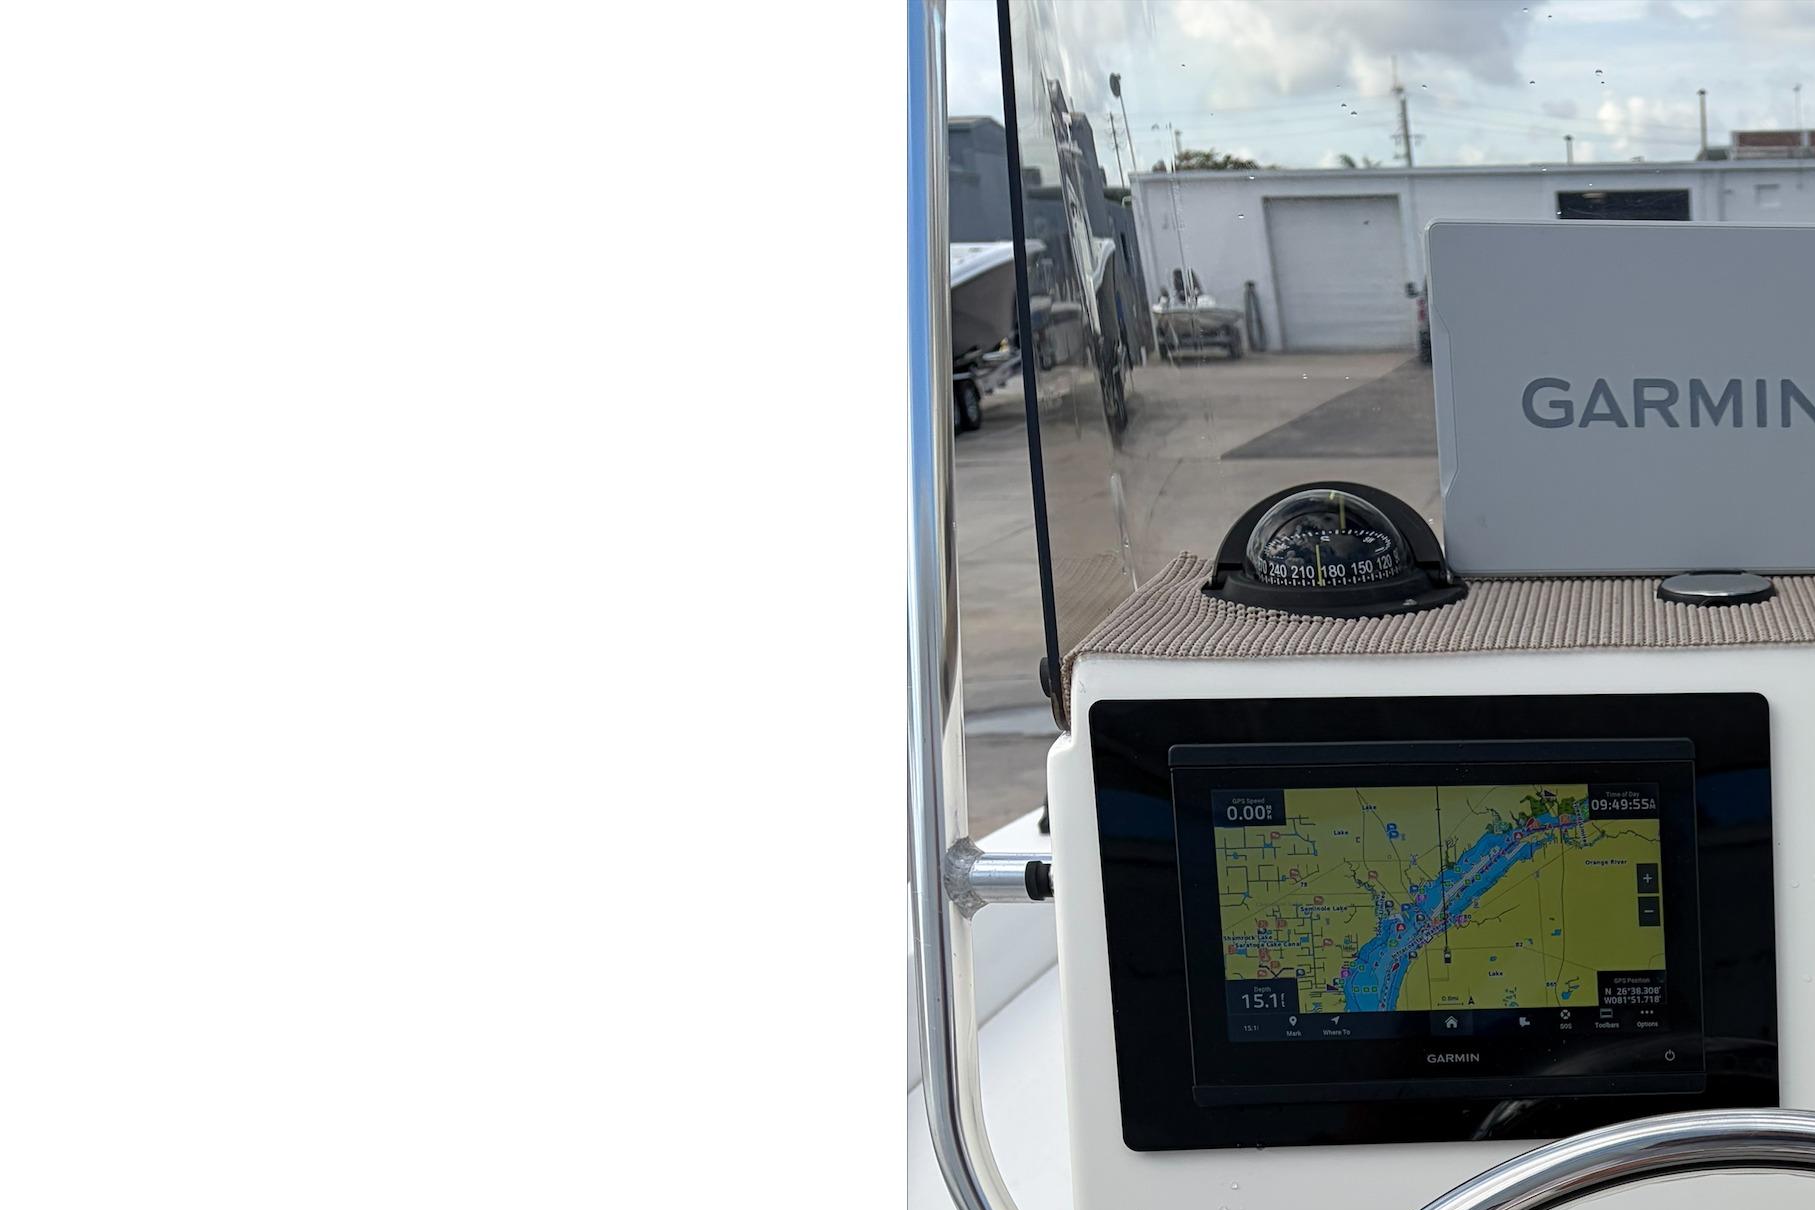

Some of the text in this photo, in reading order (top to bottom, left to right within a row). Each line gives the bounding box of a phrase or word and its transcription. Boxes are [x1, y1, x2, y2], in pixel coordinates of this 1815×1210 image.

[1270, 563, 1287, 579] 240
[1291, 565, 1315, 579] 210
[1322, 563, 1346, 579] 180
[1351, 559, 1373, 575] 150
[1376, 554, 1393, 571] 120
[1591, 798, 1649, 810] 09:49:55
[1227, 805, 1266, 820] 0.00
[1241, 992, 1278, 1009] 15.1
[1427, 1053, 1480, 1064] GARMIN
